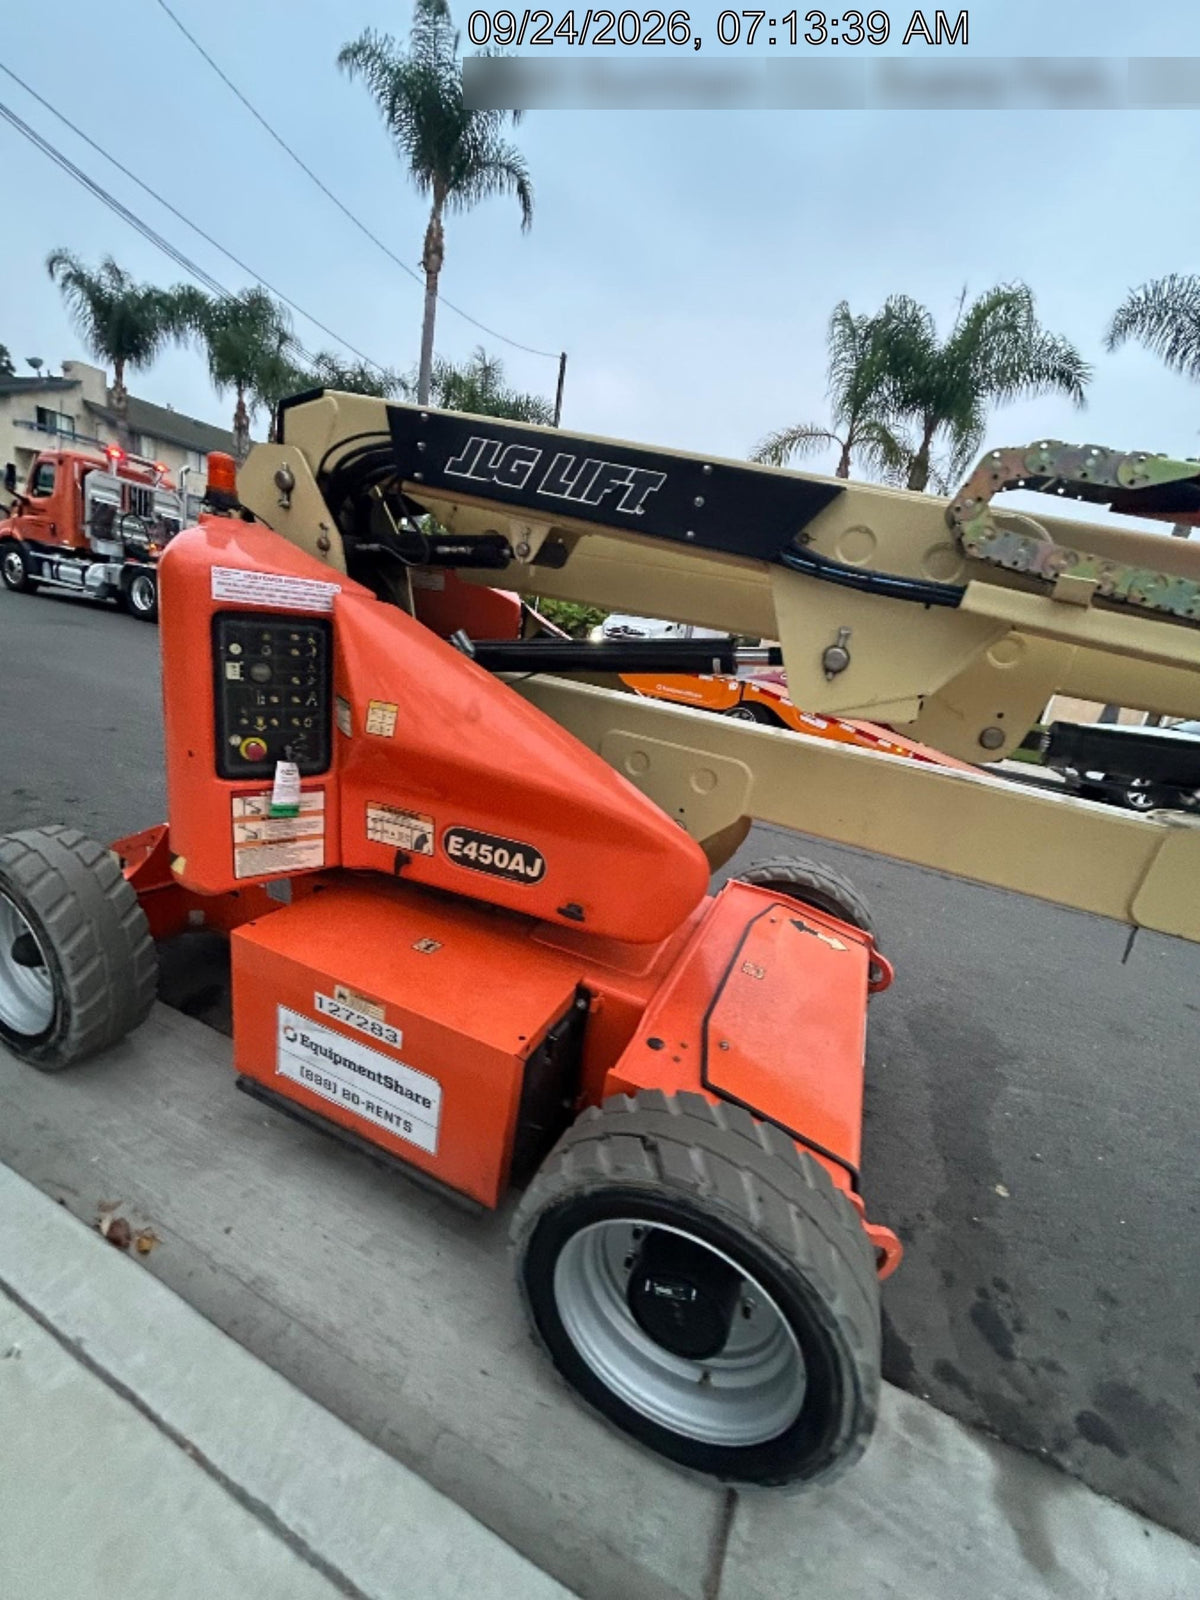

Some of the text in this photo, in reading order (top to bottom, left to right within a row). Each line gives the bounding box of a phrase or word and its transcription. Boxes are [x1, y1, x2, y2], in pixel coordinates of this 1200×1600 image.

[444, 436, 668, 515] JLG LIFT
[448, 834, 543, 879] E450AJ
[316, 996, 398, 1044] 127283
[300, 1032, 431, 1109] EquipmentShare
